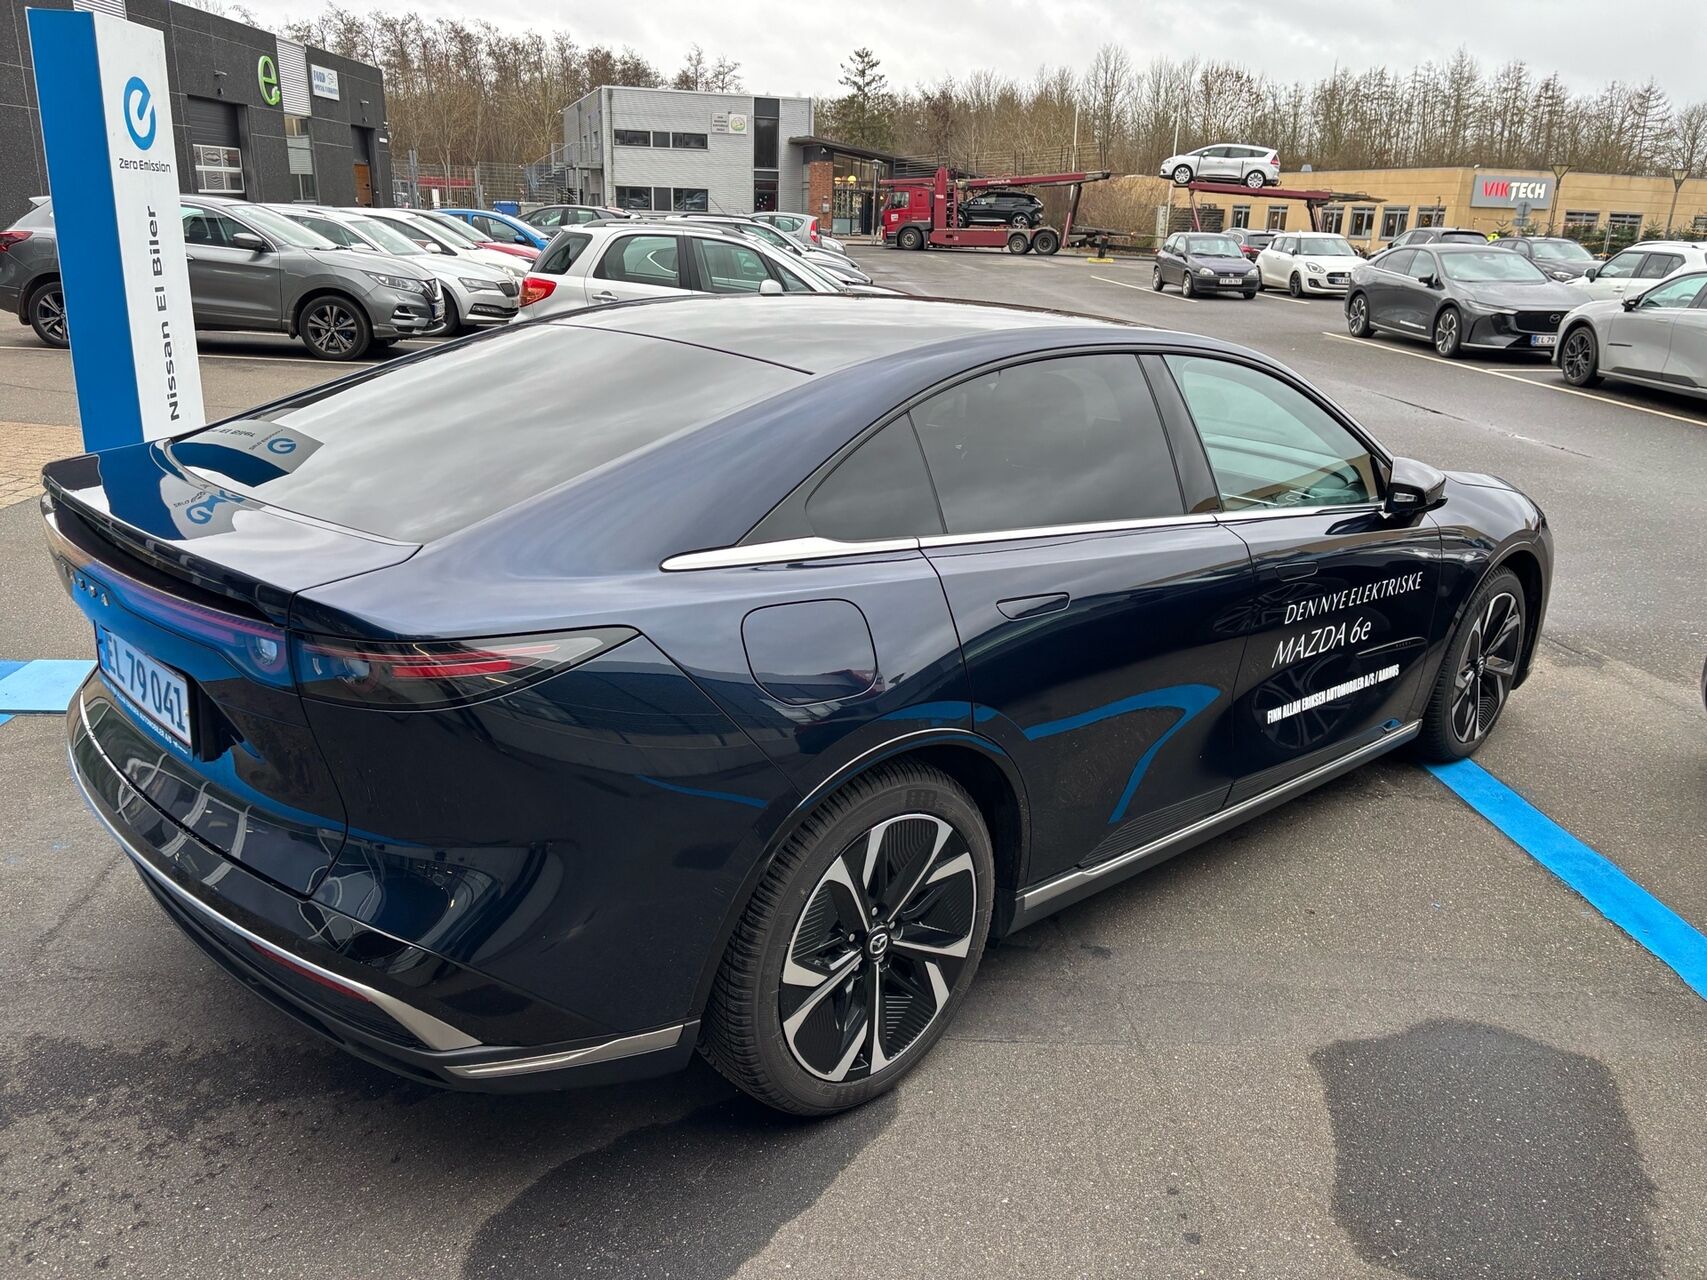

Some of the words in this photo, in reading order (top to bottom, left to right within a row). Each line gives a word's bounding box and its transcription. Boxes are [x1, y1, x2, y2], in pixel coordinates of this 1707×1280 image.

[119, 158, 138, 170] Zero
[139, 160, 171, 173] Emission
[1483, 180, 1547, 202] VIKTECH
[147, 205, 163, 277] Biler
[154, 286, 167, 312] El
[159, 321, 180, 421] Nissan
[1284, 598, 1319, 625] DEN
[1318, 590, 1349, 615] NYE
[1348, 571, 1423, 607] ELEKTRISKE
[1271, 622, 1347, 669] MAZDA
[1350, 616, 1372, 644] 6e
[106, 634, 125, 684] EL
[125, 650, 147, 703] 79
[150, 669, 186, 733] 041
[1267, 706, 1282, 725] FINN
[1282, 699, 1301, 719] ALLAN
[1301, 690, 1326, 712] ERIKSEN
[1326, 676, 1365, 702] AUTOMOBILER
[1364, 672, 1375, 688] A/S
